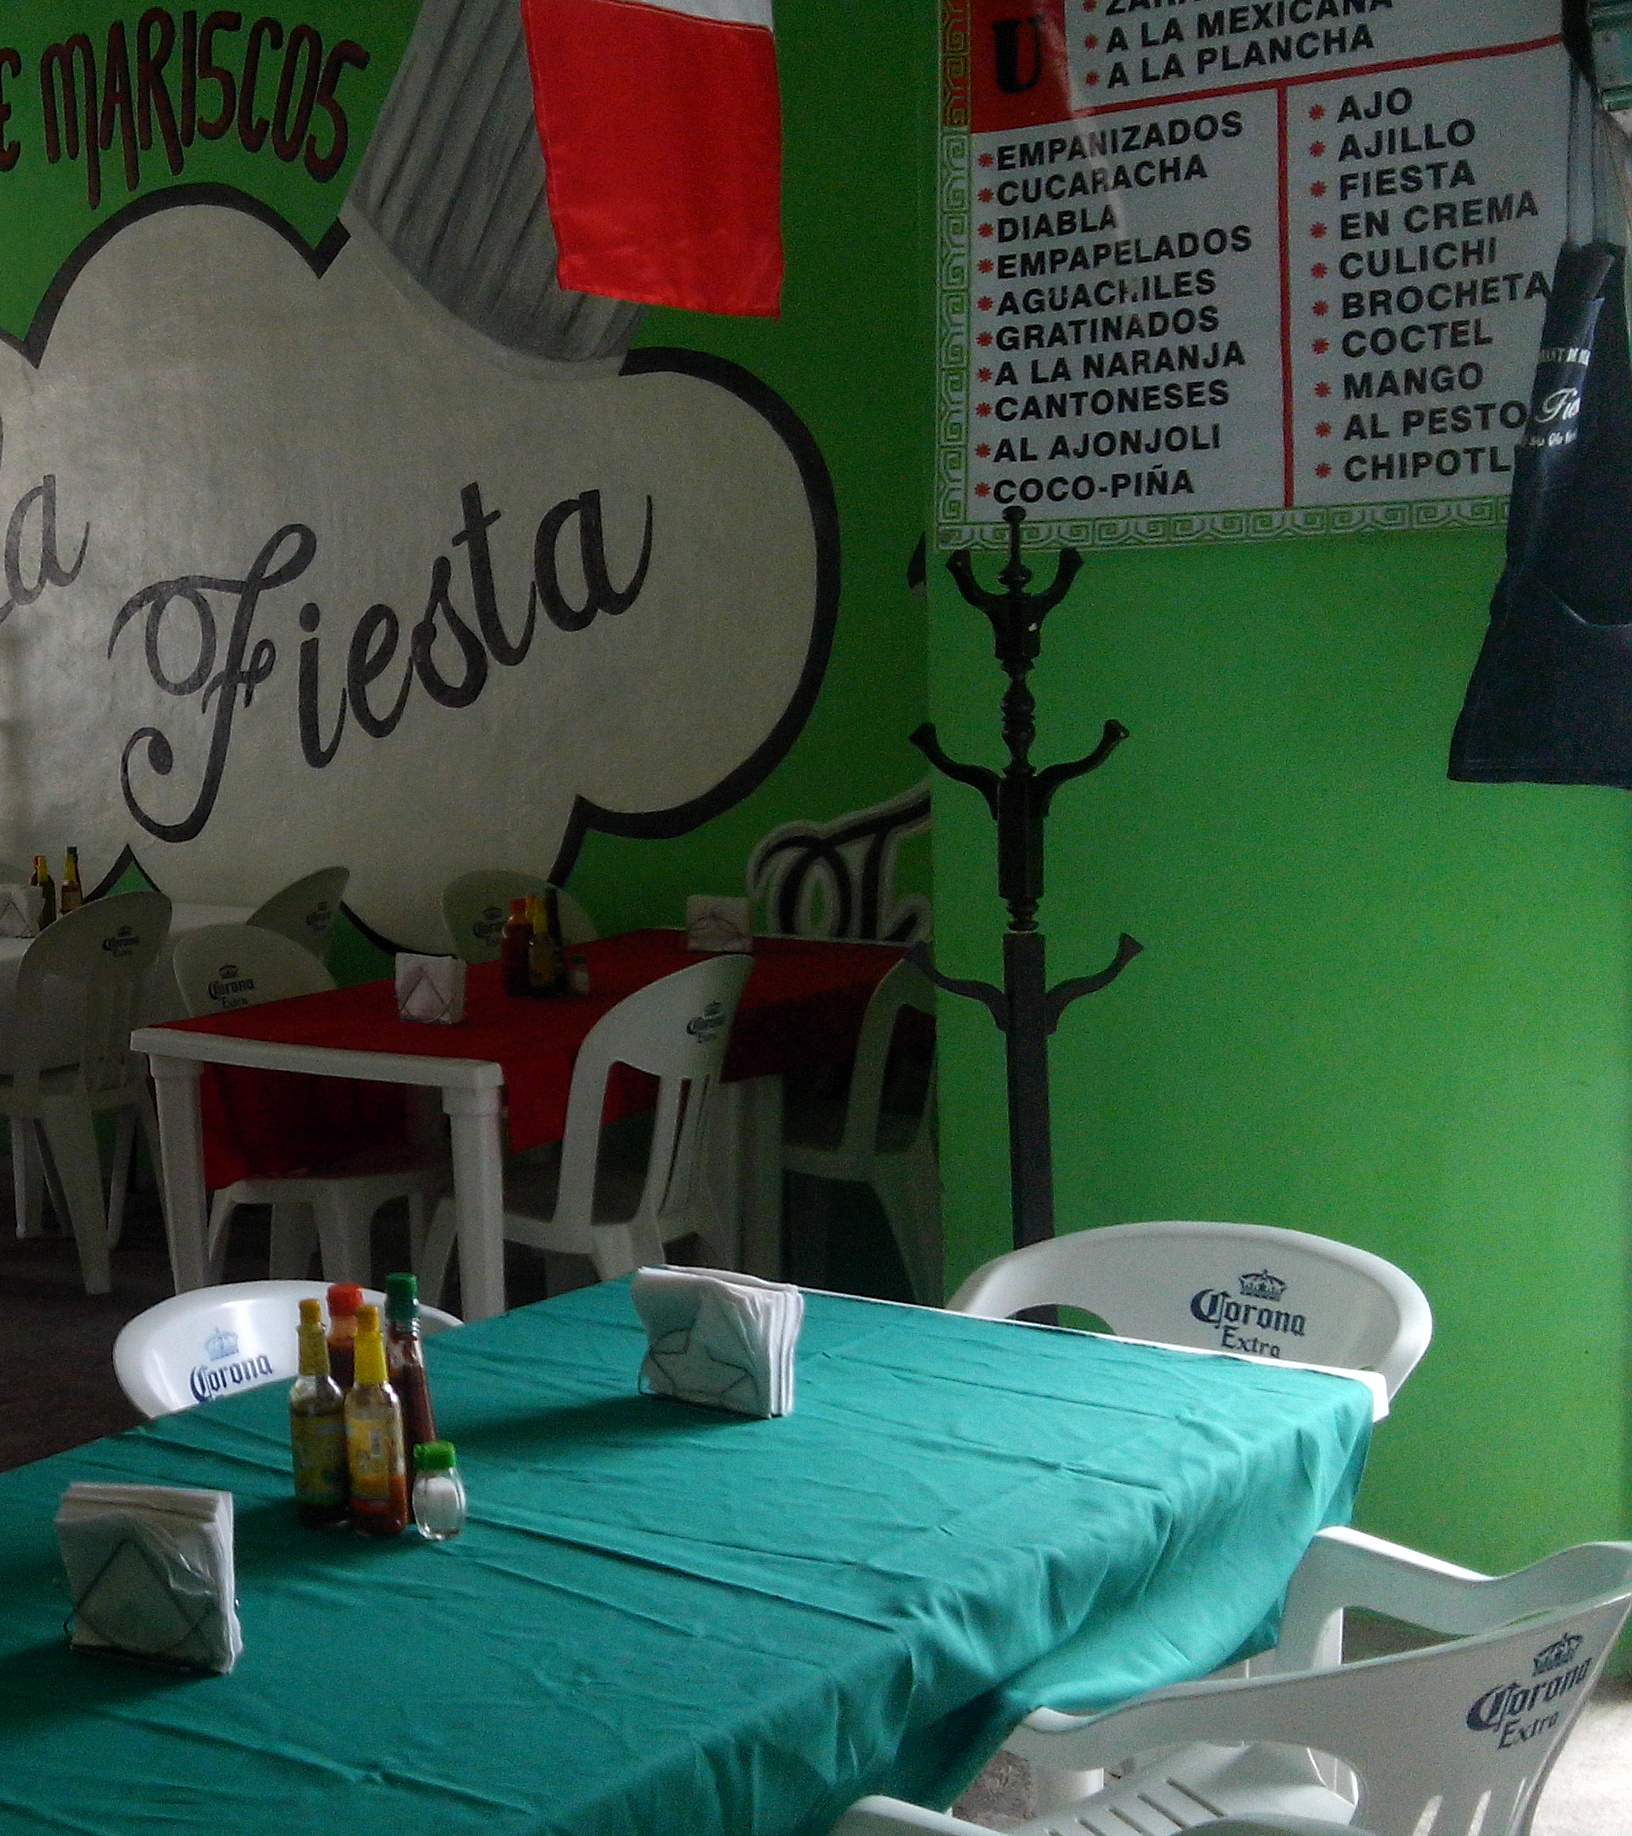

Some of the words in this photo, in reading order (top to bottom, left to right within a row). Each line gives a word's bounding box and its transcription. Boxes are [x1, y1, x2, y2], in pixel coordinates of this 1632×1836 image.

[991, 14, 1045, 94] U
[1106, 25, 1129, 53] A
[1141, 17, 1184, 47] LA
[1106, 62, 1129, 89] A
[1141, 56, 1185, 84] LA
[1197, 24, 1374, 75] PLANCHA
[39, 7, 369, 209] MARISCOS
[1337, 87, 1413, 123] AJO
[997, 110, 1244, 171] EMPANIZADOS
[1338, 118, 1476, 162] AJILLO
[997, 154, 1208, 206] CUCARACHA
[1339, 159, 1476, 201] FIESTA
[997, 205, 1118, 243] DIABLA
[1340, 210, 1389, 240] EN
[1404, 189, 1539, 233] CREMA
[997, 225, 1252, 279] EMPAPELADOS
[1339, 237, 1497, 279] CULICHI
[997, 269, 1216, 316] AGUACHILES
[1342, 271, 1552, 319] BROCHETA
[995, 305, 1219, 352] GRATINADOS
[1342, 318, 1493, 358] COCTEL
[995, 361, 1018, 386] A
[1031, 357, 1071, 384] LA
[1083, 341, 1246, 379] NARANJA
[1343, 362, 1483, 400] MANGO
[995, 379, 1229, 422] CANTONESES
[1343, 413, 1389, 441] AL
[1402, 400, 1528, 437] PESTO
[993, 437, 1038, 463] AL
[1048, 423, 1220, 460] AJONJOLI
[1344, 446, 1512, 482] CHIPOTL
[993, 464, 1194, 503] COCO-PIÑA
[108, 480, 653, 842] Fiesta
[209, 978, 255, 1000] Corona
[1191, 1288, 1306, 1337] Corona
[1221, 1324, 1280, 1359] Extra
[189, 1353, 273, 1403] Corona
[1466, 1658, 1592, 1730] Corona
[1498, 1711, 1559, 1749] Extra
